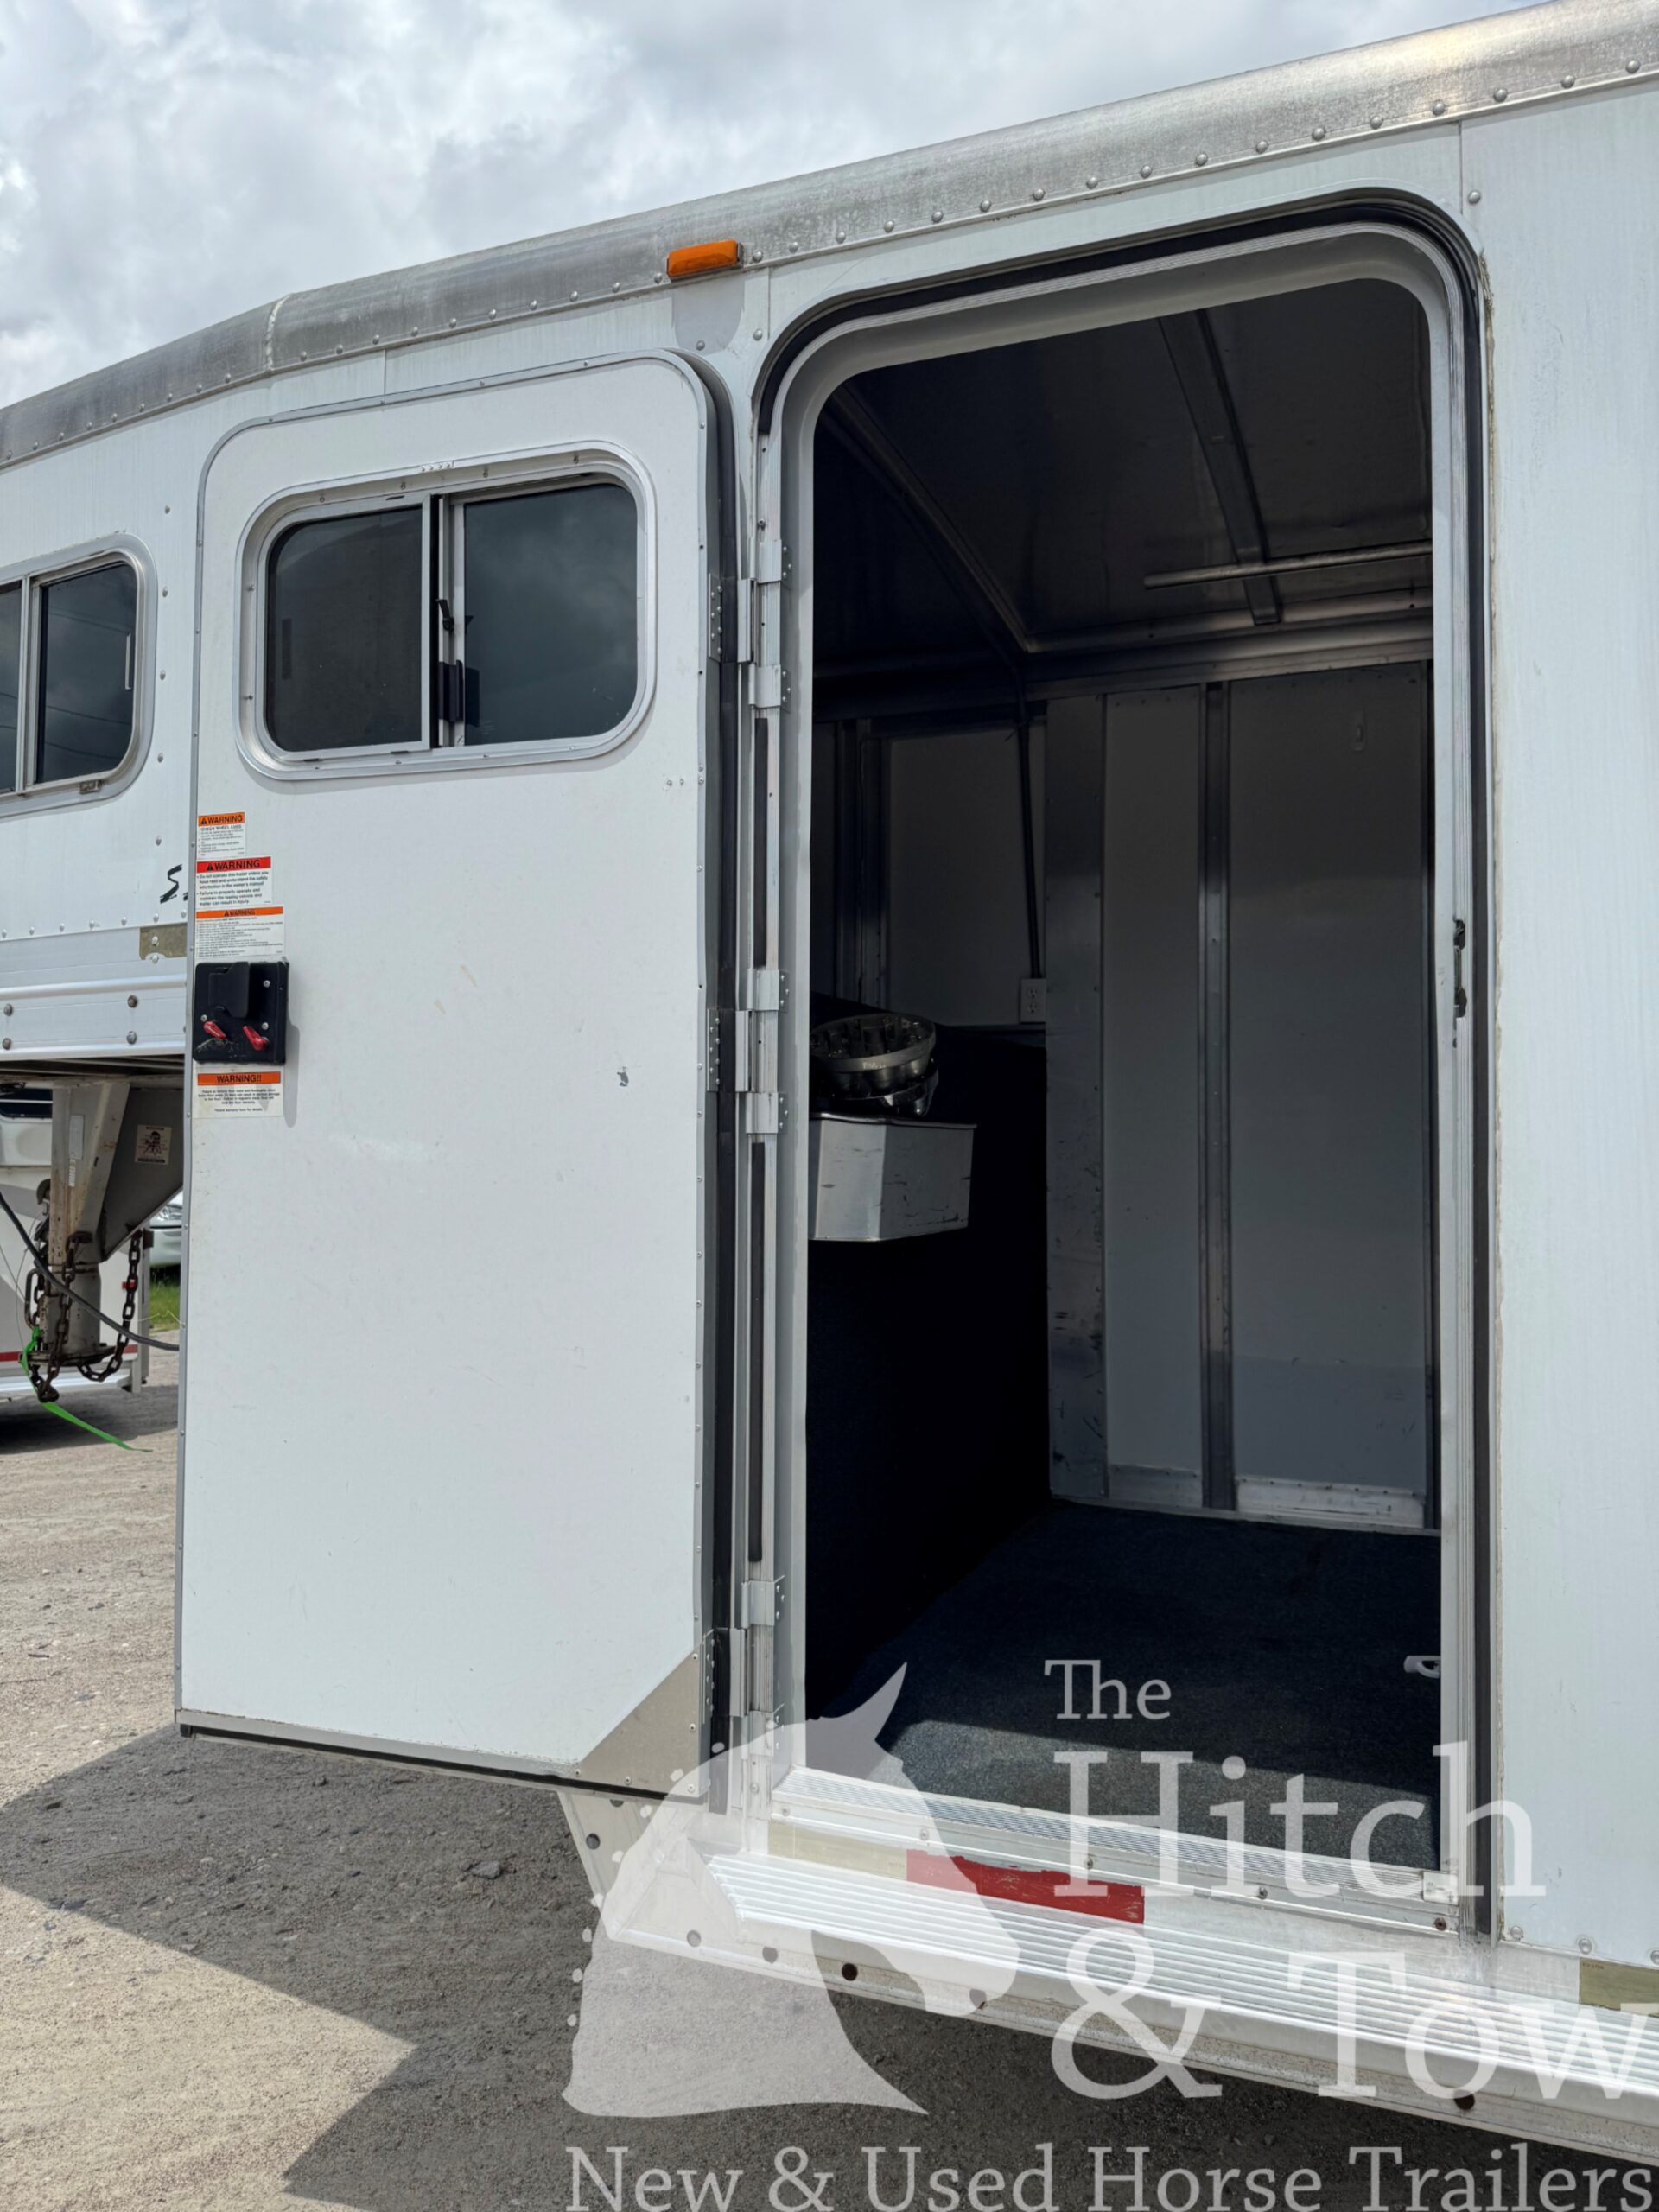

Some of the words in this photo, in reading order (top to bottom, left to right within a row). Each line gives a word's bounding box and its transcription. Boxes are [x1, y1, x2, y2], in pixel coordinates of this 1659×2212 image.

[207, 815, 243, 825] WARNING
[213, 860, 260, 871] WARNING
[216, 1074, 262, 1084] WARNING!!
